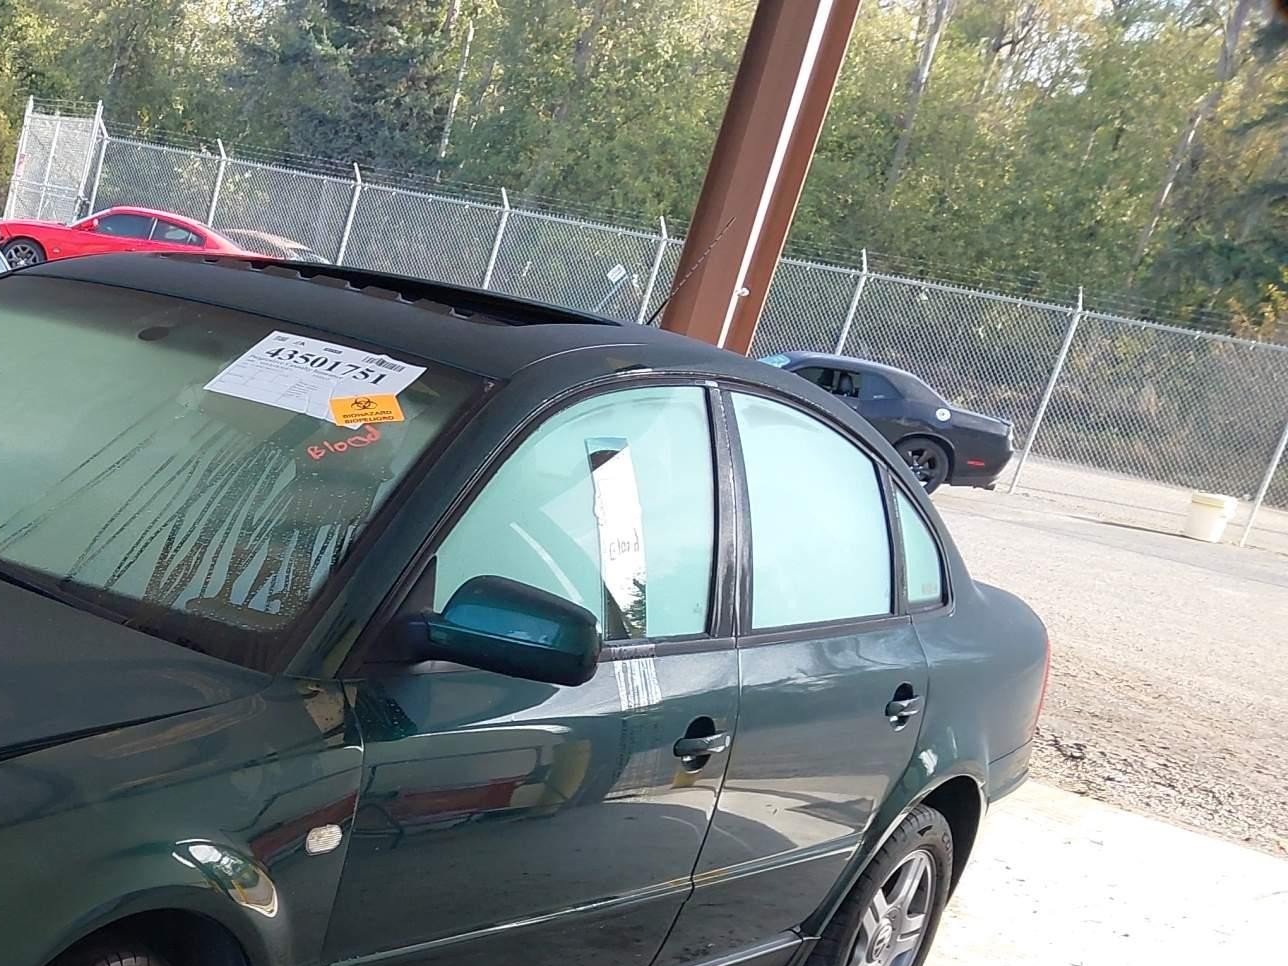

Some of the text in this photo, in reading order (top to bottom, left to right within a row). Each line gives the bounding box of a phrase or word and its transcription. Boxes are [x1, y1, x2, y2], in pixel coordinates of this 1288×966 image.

[266, 347, 387, 385] 43501751
[343, 410, 393, 419] BIOHAZARD
[307, 425, 381, 460] Blood
